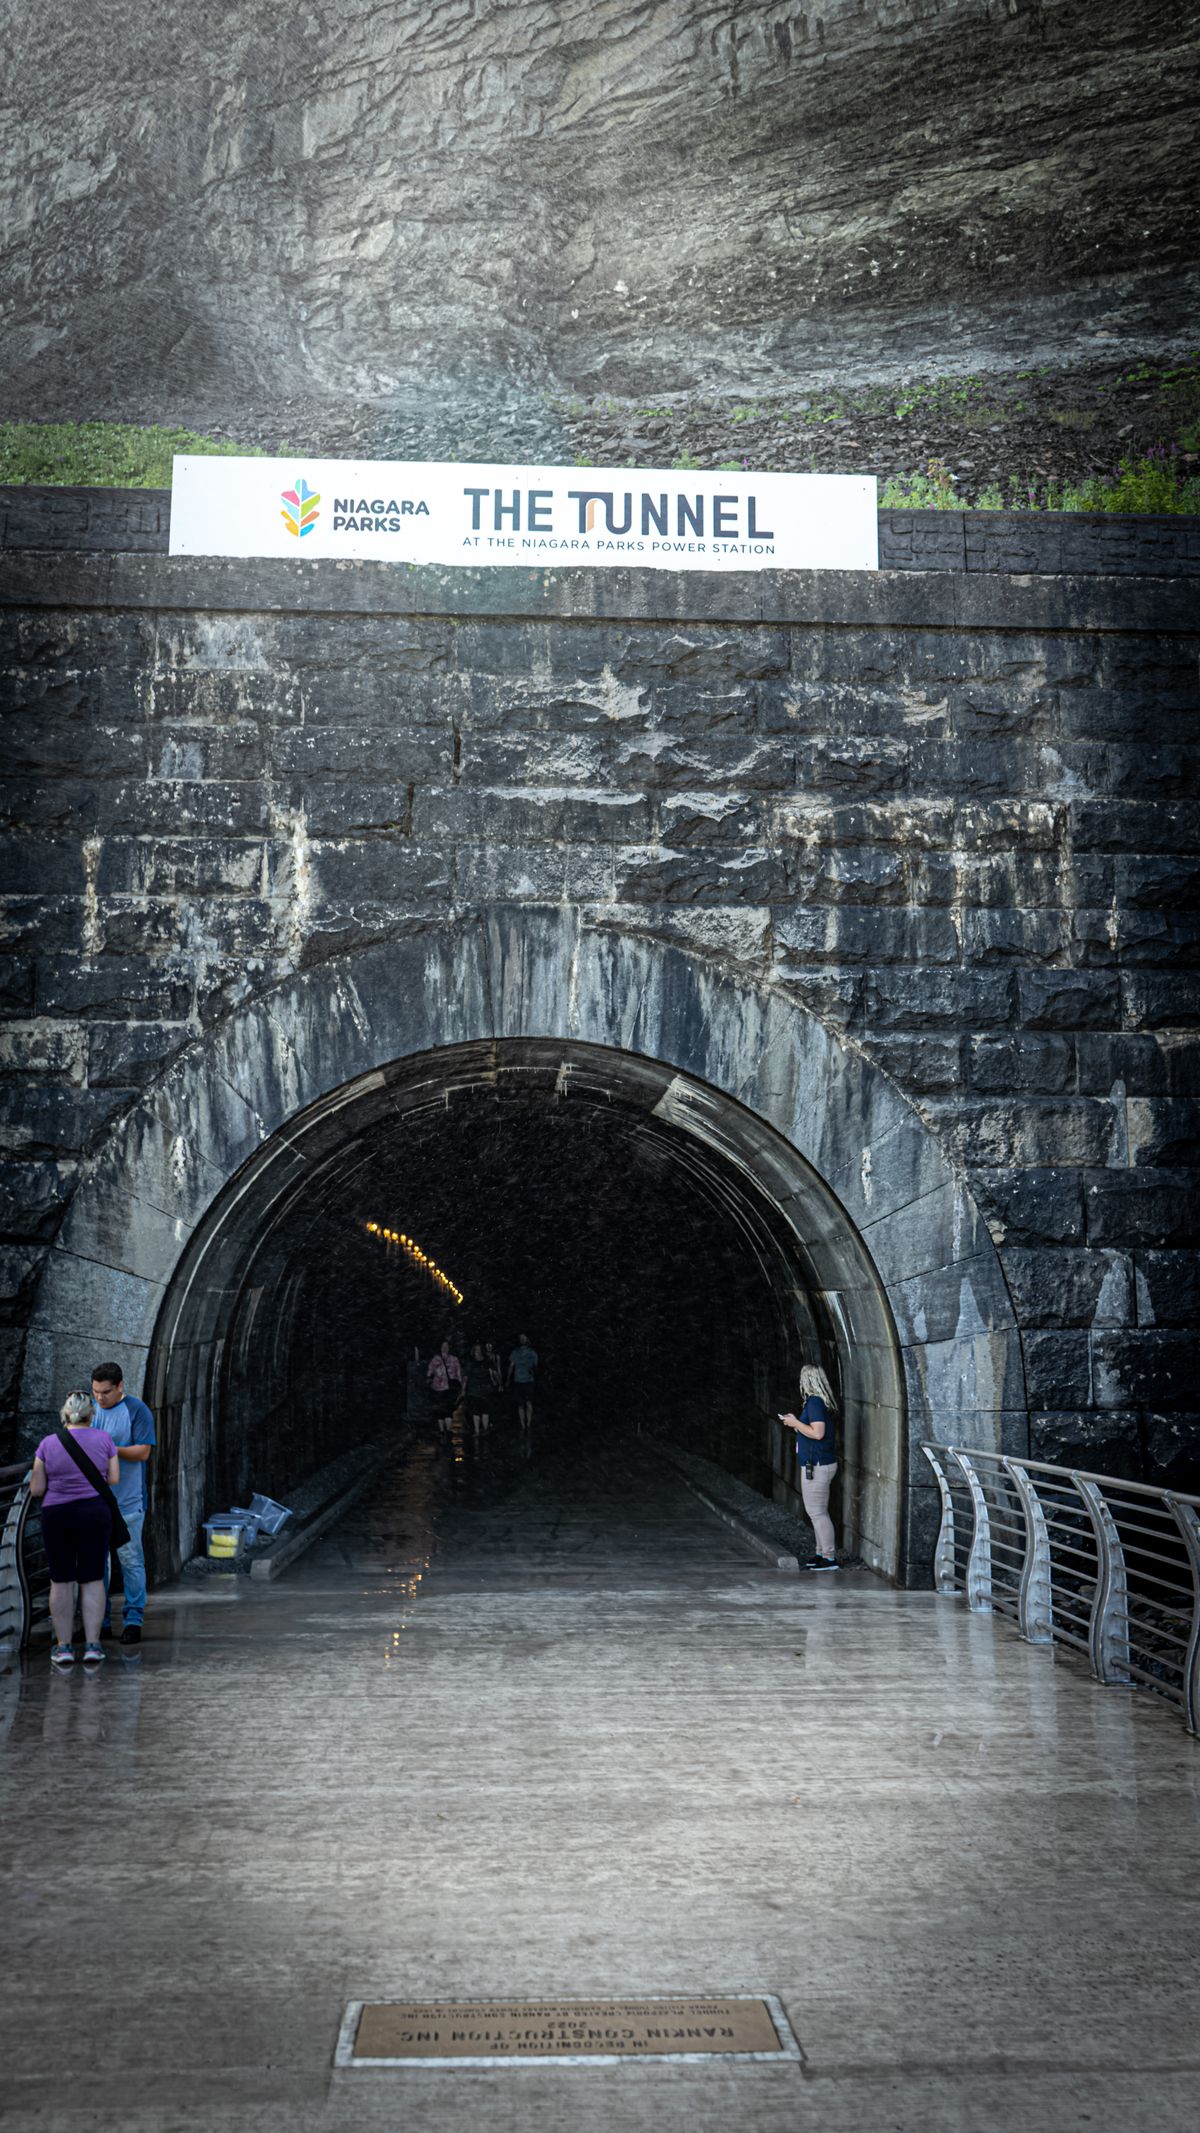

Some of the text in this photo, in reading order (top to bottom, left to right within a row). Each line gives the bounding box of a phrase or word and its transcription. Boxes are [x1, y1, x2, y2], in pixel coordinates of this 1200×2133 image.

[334, 498, 430, 516] NIAGARA
[463, 488, 774, 539] THE TUNNEL
[333, 515, 401, 532] PARKS
[462, 537, 775, 554] AT THE NIAGARA PARKS POWER STATION
[547, 2021, 587, 2029] 2022
[396, 2027, 735, 2042] RANKIN CONSTRUCTION INC.
[517, 2041, 625, 2049] RECOGNITION
